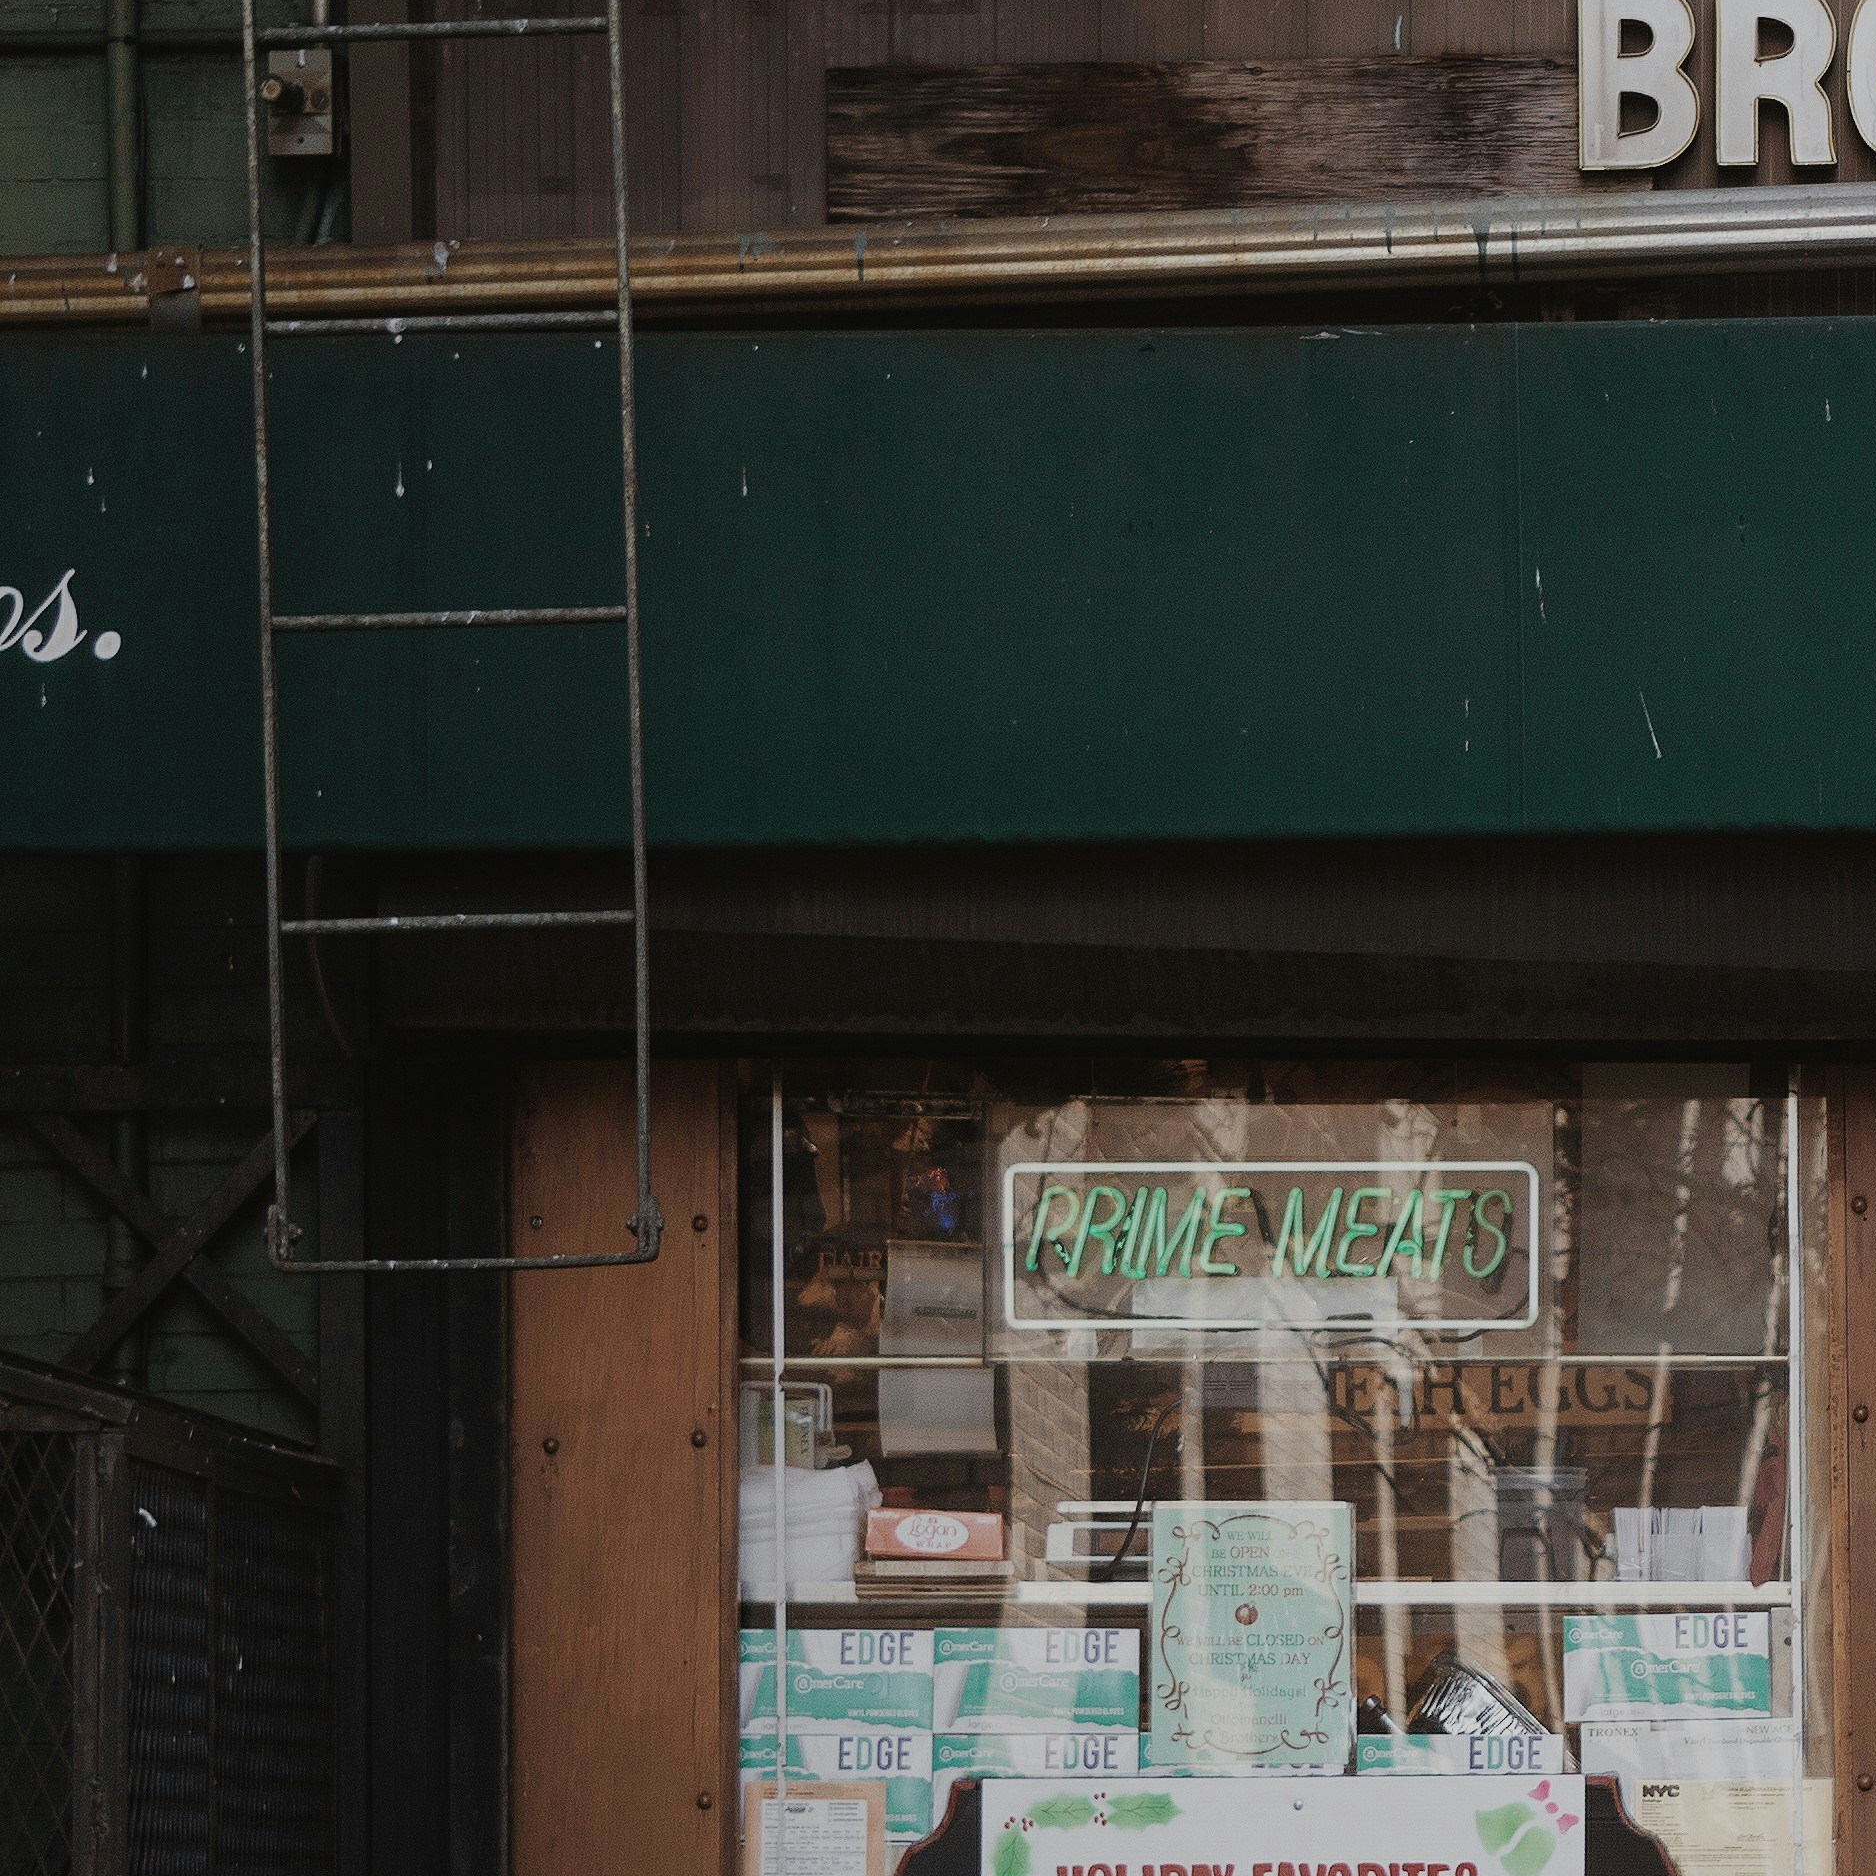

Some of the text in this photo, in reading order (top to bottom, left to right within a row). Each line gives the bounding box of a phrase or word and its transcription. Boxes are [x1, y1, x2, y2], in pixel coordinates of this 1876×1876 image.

[1025, 1185, 1512, 1281] PRIME MEATS
[1227, 1531, 1244, 1541] WE
[1211, 1549, 1226, 1559] BE
[1230, 1546, 1270, 1559] OPEN
[1192, 1565, 1279, 1578] CHRISTMAS
[1199, 1584, 1304, 1598] UNTIL 2:00 pm
[1246, 1633, 1304, 1646] CLOSED
[1675, 1614, 1749, 1649] EDGE
[841, 1631, 915, 1665] EDGE
[1046, 1629, 1120, 1663] EDGE
[1189, 1653, 1312, 1666] CHRISTMAS DAY
[838, 1737, 912, 1770] EDGE
[1045, 1735, 1119, 1769] EDGE
[1469, 1735, 1543, 1770] EDGE
[1642, 1784, 1680, 1798] NYC
